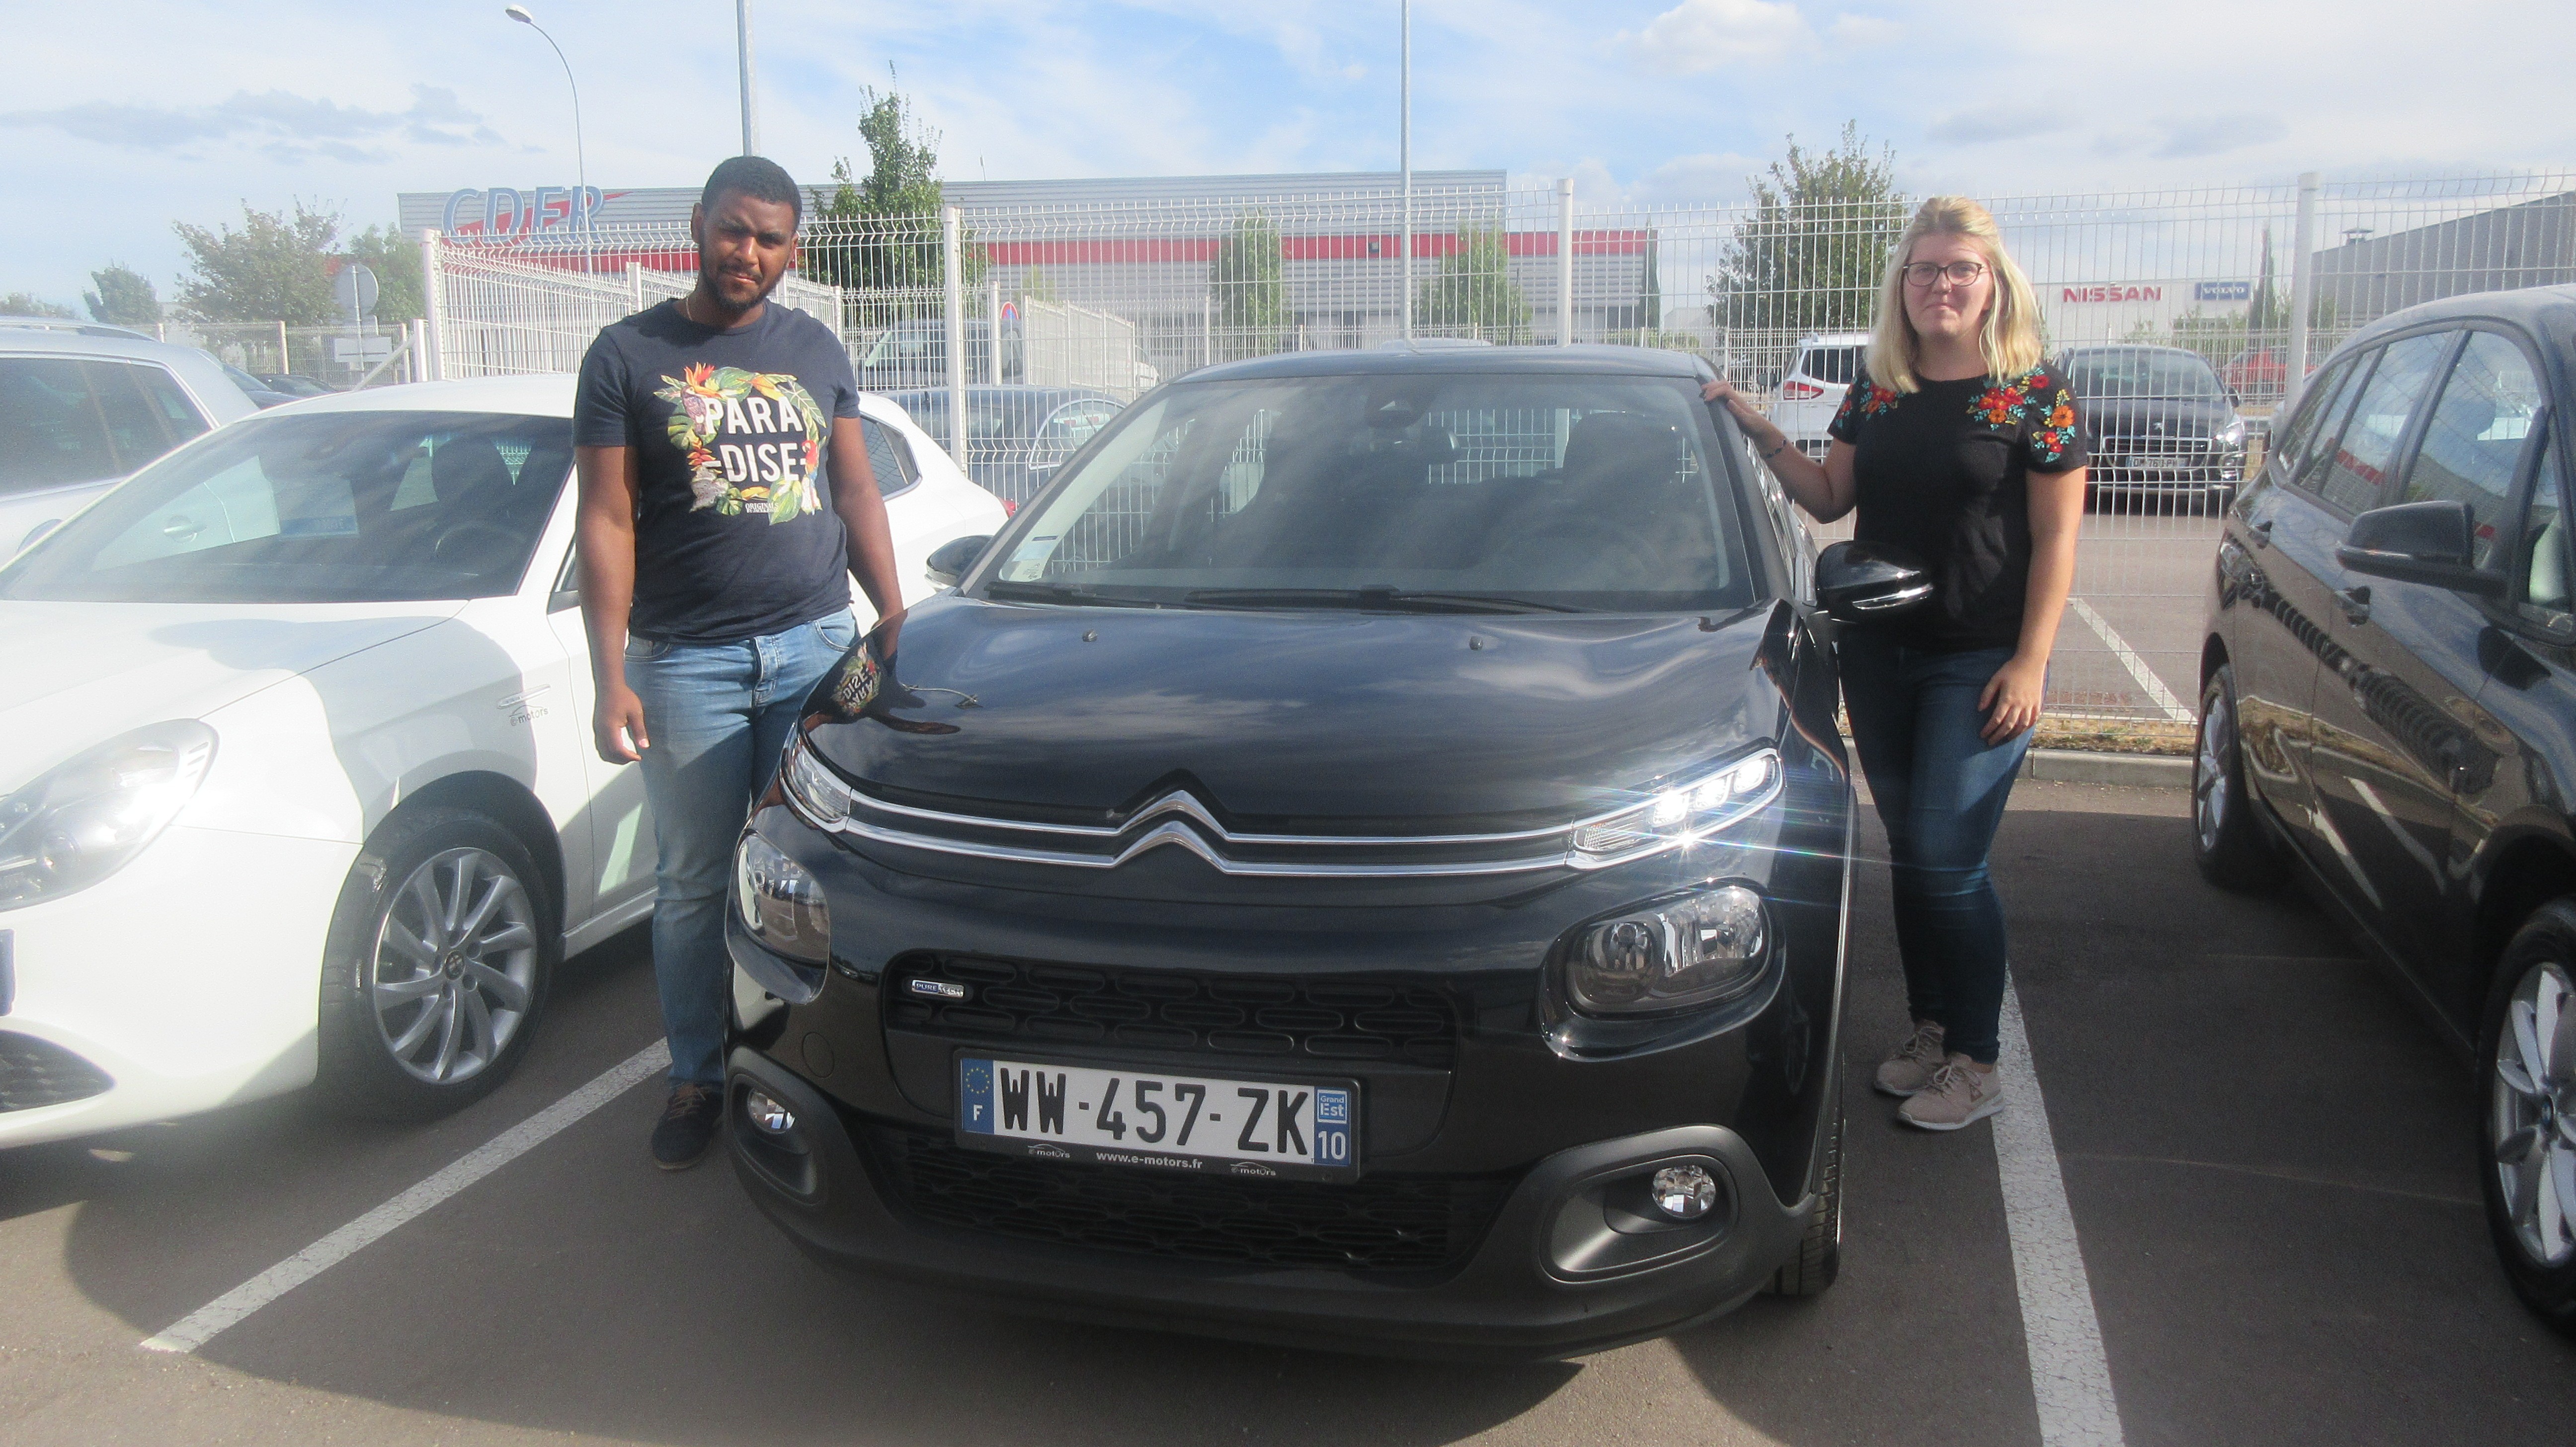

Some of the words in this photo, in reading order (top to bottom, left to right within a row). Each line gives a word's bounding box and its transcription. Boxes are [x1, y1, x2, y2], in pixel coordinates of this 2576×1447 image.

[442, 186, 604, 243] CDER
[2063, 286, 2162, 302] NISSAN
[704, 396, 805, 435] PARA
[916, 983, 937, 991] PURE
[973, 1104, 983, 1121] F
[1000, 1067, 1309, 1156] WW-457-ZK
[1320, 1103, 1344, 1117] Est
[1318, 1130, 1346, 1160] 10
[1096, 1152, 1203, 1168] www.e-motors.fr
